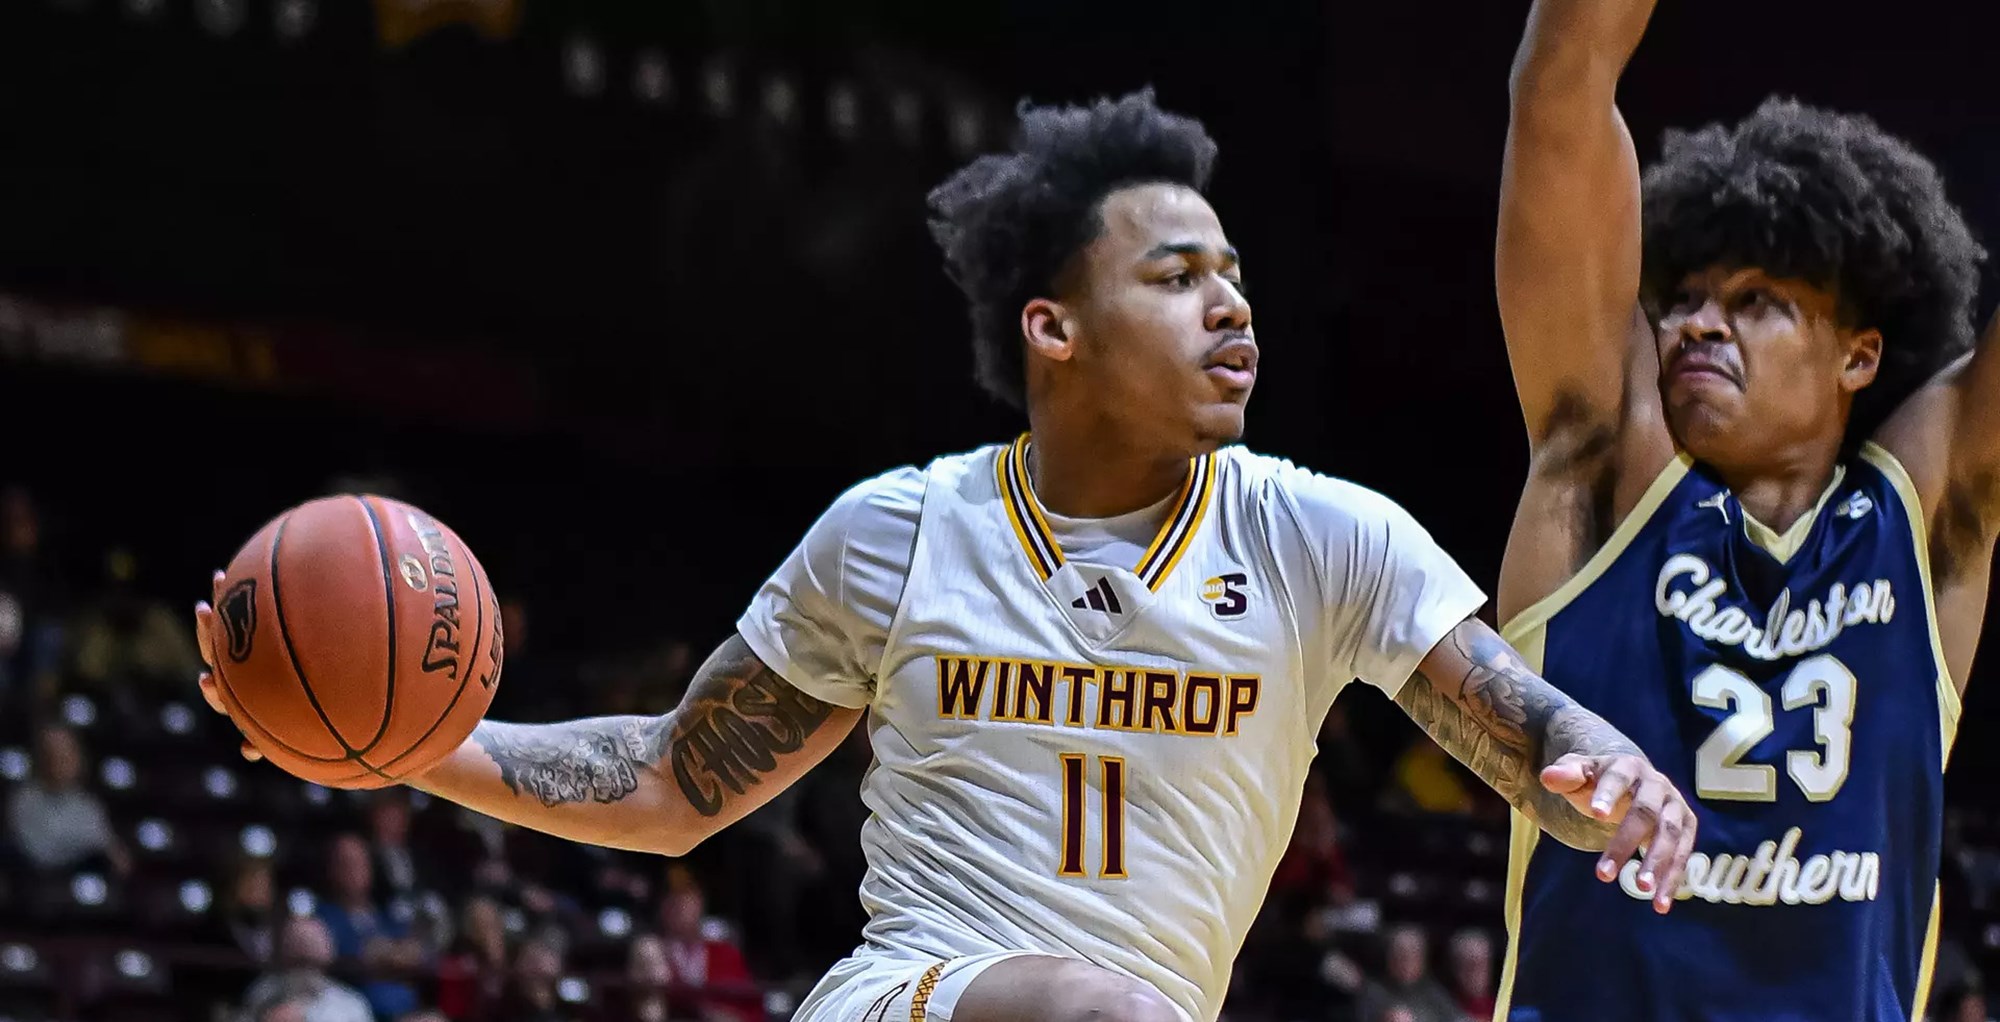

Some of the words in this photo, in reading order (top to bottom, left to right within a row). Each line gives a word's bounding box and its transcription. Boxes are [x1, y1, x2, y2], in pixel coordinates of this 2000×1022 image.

[1655, 553, 1896, 661] Charleston
[936, 655, 1262, 737] WINTHROP
[1692, 653, 1857, 802] 23
[1056, 753, 1128, 879] 11
